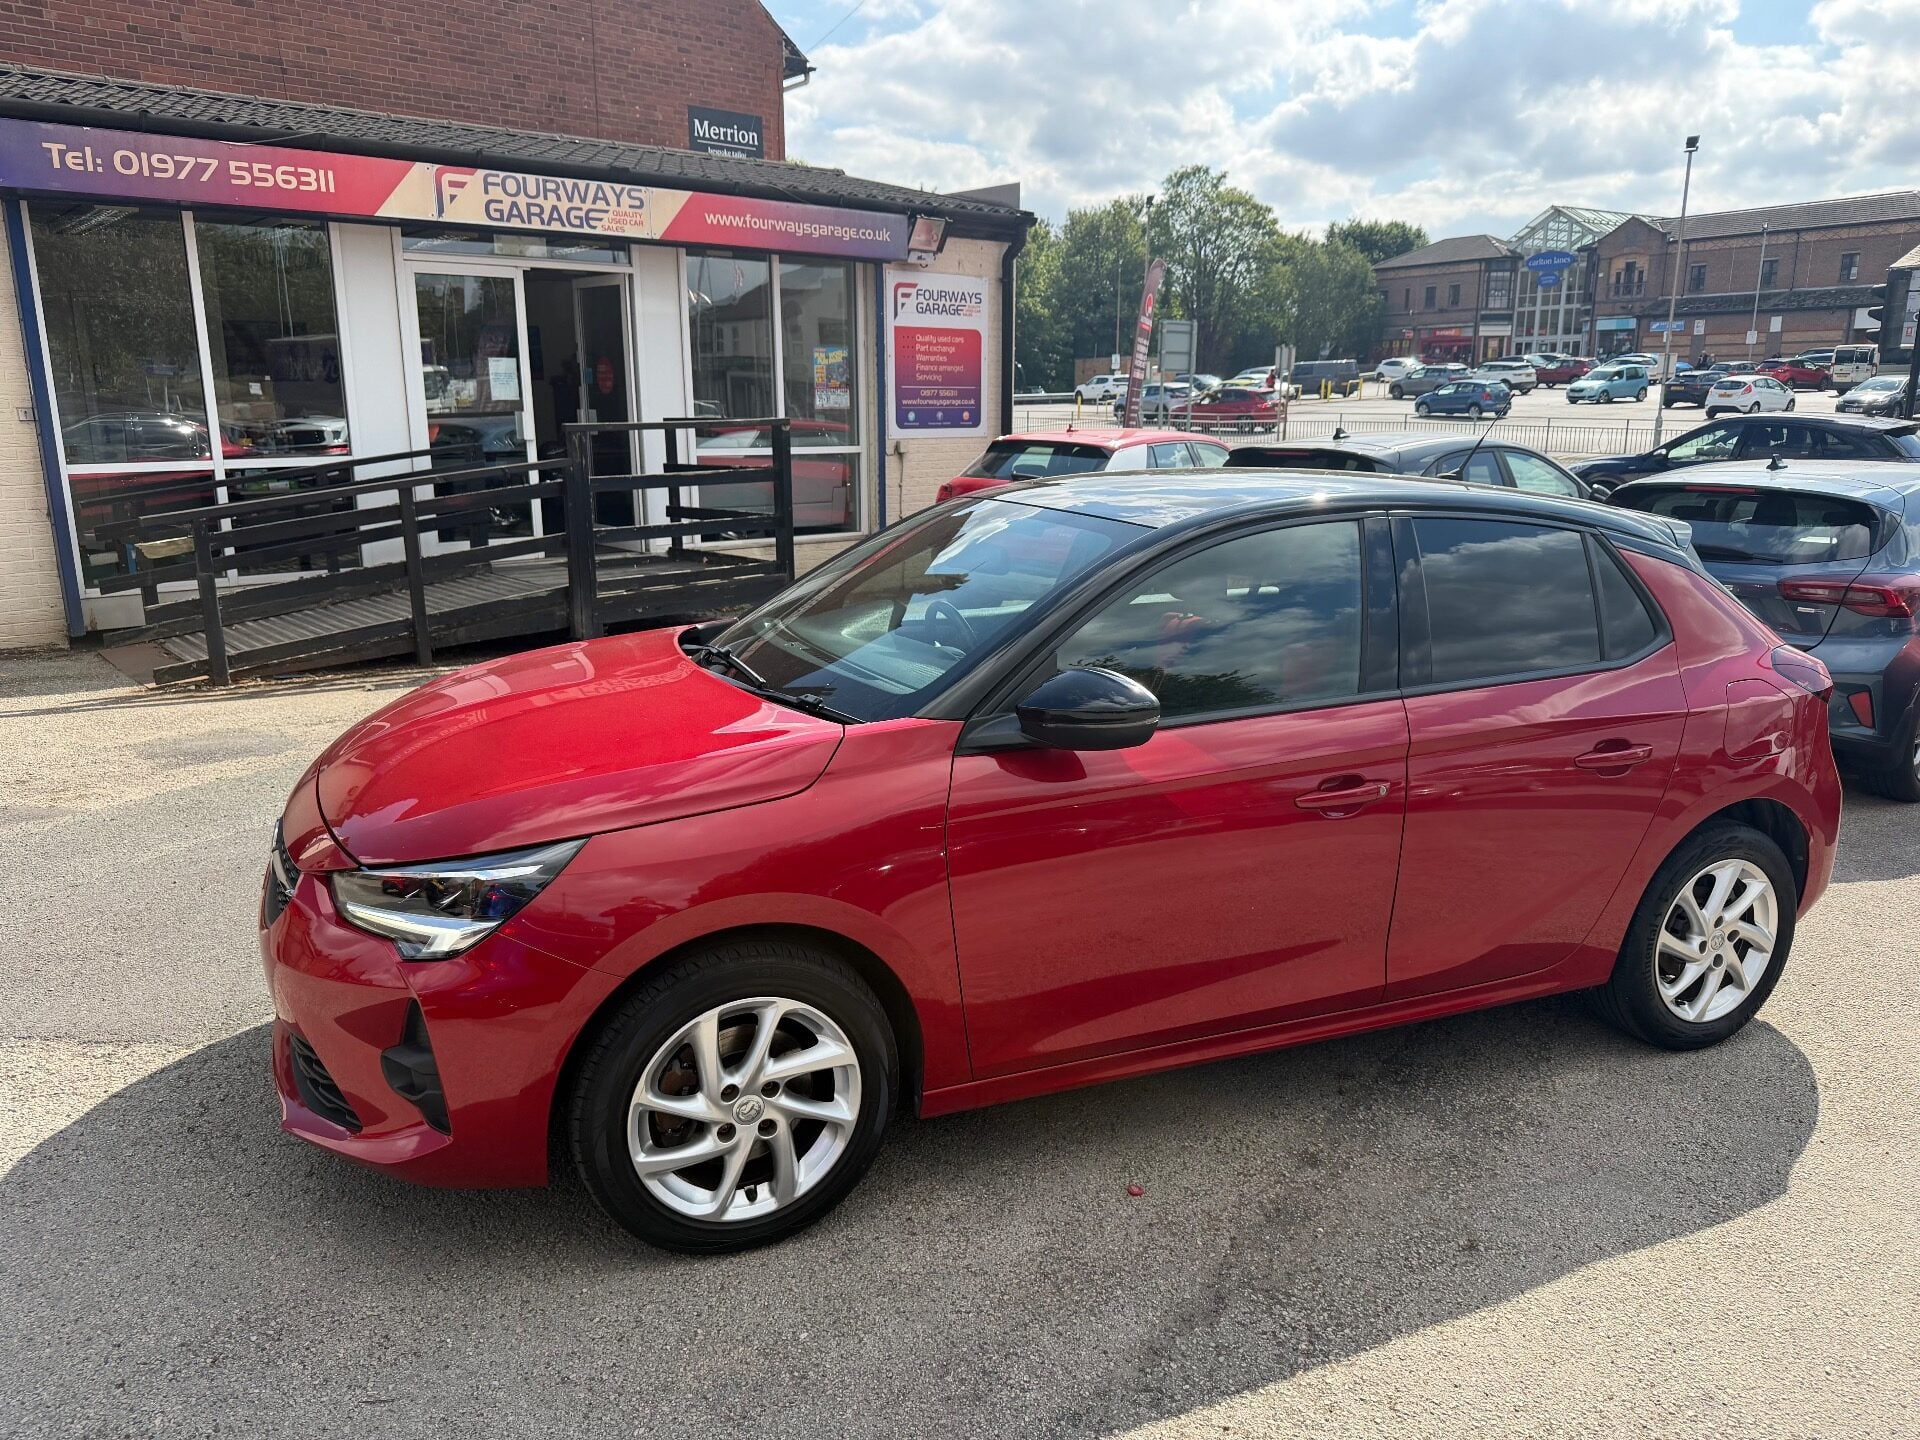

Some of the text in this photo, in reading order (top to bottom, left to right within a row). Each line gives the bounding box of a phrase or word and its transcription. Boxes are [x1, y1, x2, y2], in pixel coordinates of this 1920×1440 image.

[693, 118, 759, 145] Merrion
[42, 142, 336, 193] Tel: 01977 556311
[483, 172, 645, 210] FOURWAYS
[484, 199, 610, 230] GARAGE
[612, 210, 643, 219] QUALITY
[601, 224, 626, 233] SALES
[607, 217, 644, 228] USED CAR
[704, 212, 891, 242] www.fourwaysgarage.co.uk
[916, 288, 982, 304] FOURWAYS
[916, 302, 967, 316] GARAGE
[915, 334, 936, 344] Quality
[937, 335, 951, 343] used
[915, 343, 955, 354] Part exchange
[915, 372, 942, 382] Servicing
